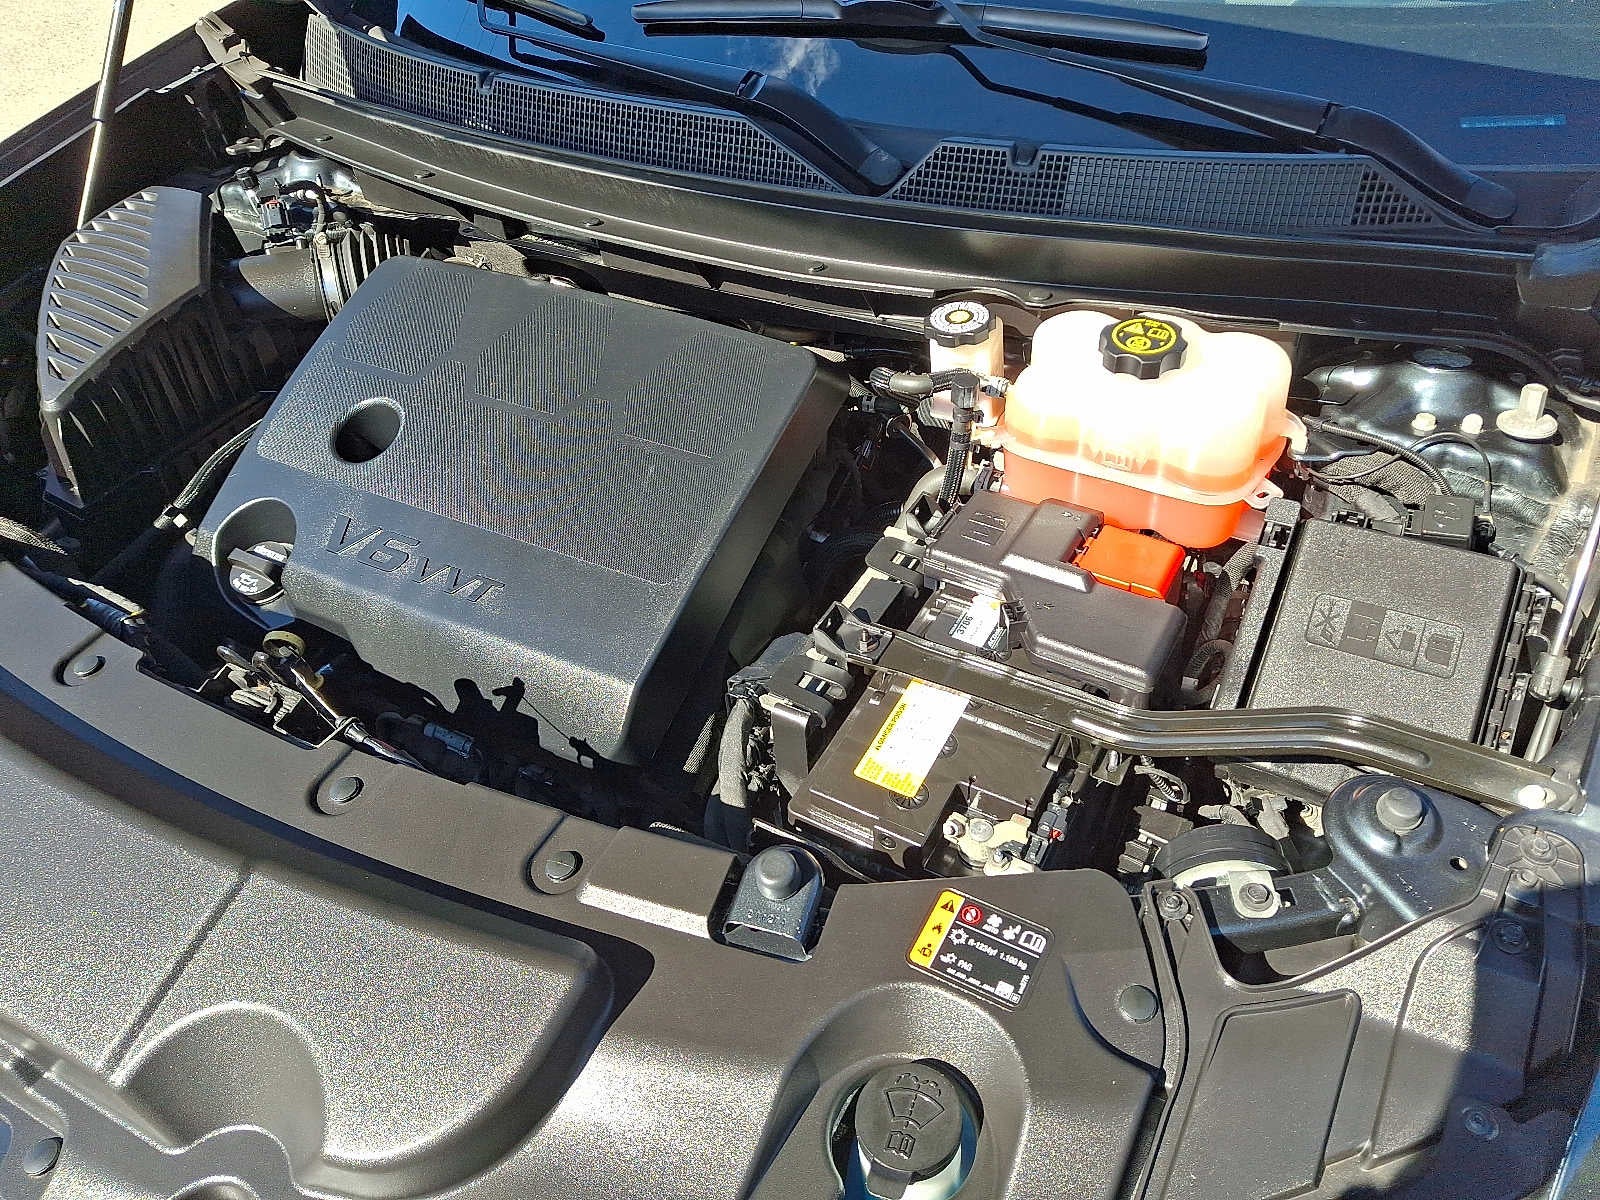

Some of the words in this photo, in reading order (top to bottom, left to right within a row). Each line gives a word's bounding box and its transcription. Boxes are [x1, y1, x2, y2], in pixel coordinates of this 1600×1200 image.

[325, 513, 421, 572] V6
[412, 554, 506, 603] VVT
[957, 959, 973, 972] PAG
